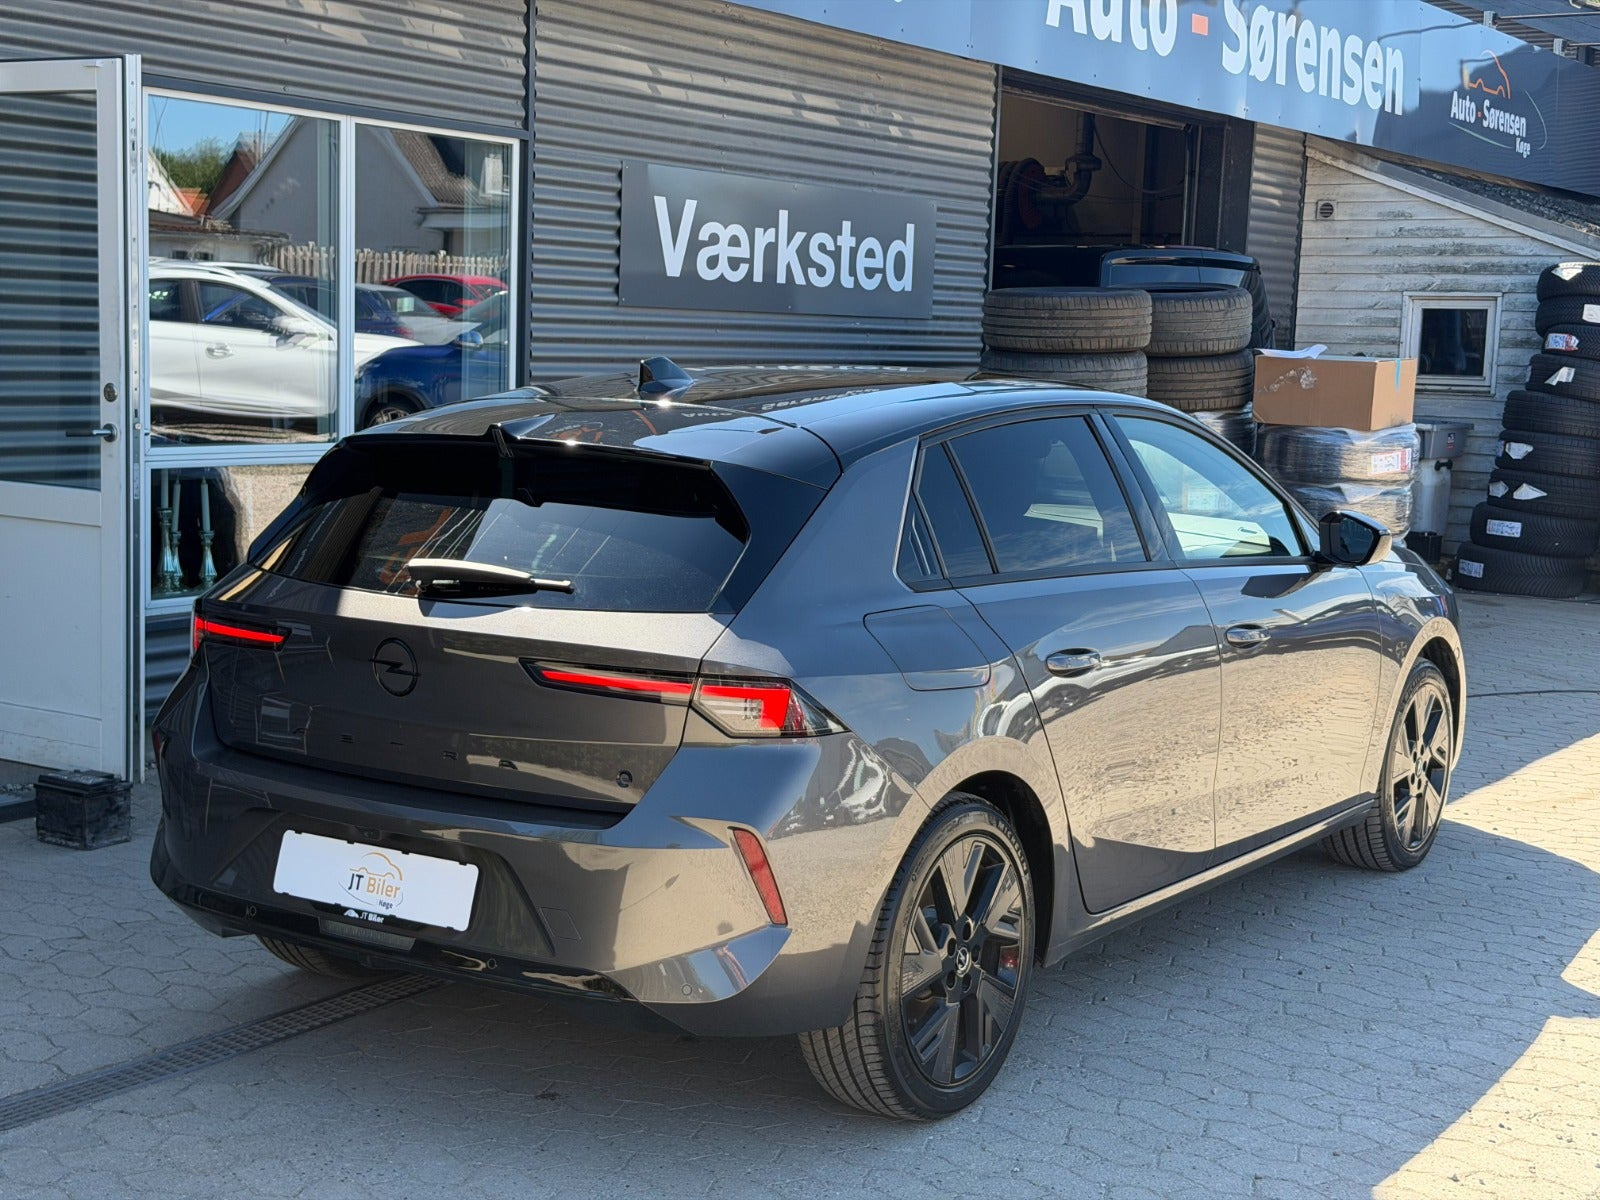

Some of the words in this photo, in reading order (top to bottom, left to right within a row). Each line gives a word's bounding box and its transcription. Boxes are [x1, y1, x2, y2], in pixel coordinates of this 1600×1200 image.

[1046, 0, 1178, 57] uto
[1222, 0, 1404, 116] Sørensen
[1450, 90, 1477, 124] Auto
[1482, 99, 1527, 138] Sørensen
[1515, 137, 1531, 159] Køge
[653, 195, 915, 292] Værksted
[348, 873, 364, 890] JT
[367, 877, 400, 898] Biler
